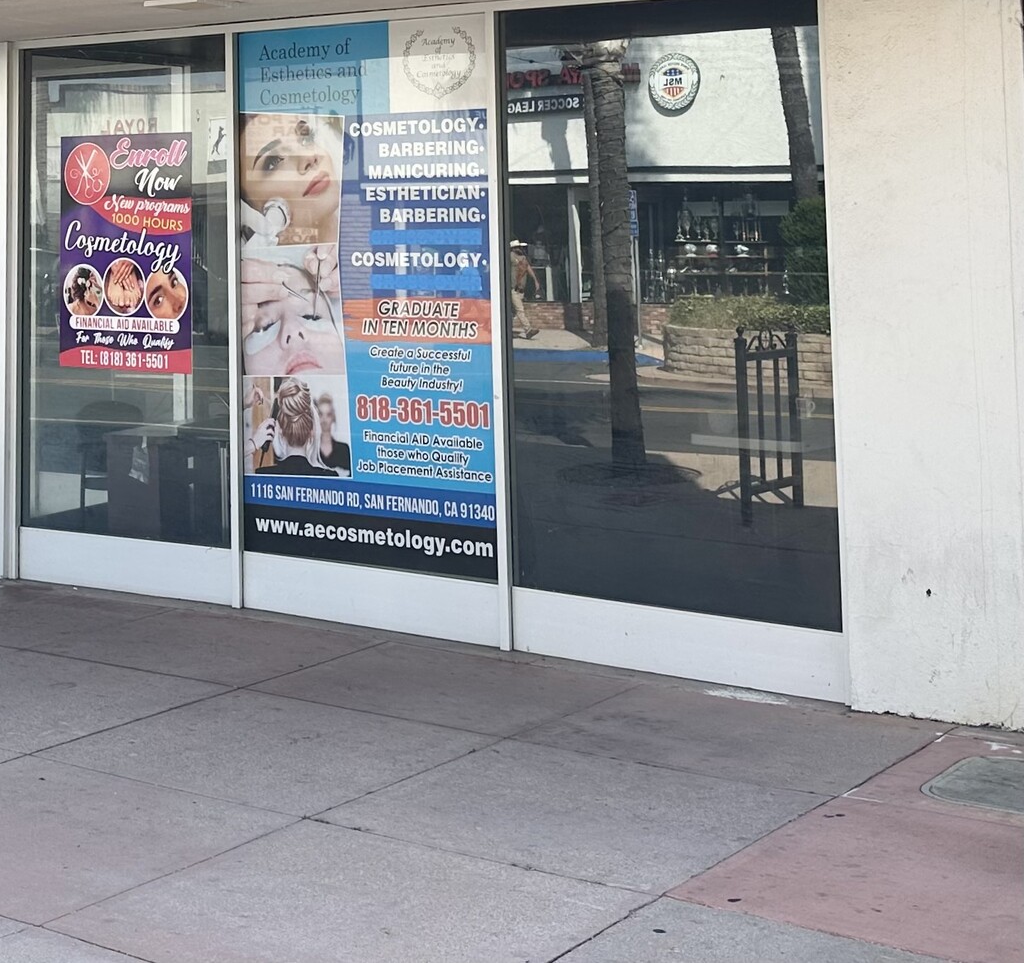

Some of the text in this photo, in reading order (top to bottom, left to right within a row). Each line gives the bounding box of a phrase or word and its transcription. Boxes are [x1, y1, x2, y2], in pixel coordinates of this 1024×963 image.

[258, 37, 352, 61] Academy of
[420, 35, 456, 48] Academy
[260, 60, 368, 83] Esthetics and
[260, 85, 361, 106] Cosmetology
[109, 137, 188, 170] Enroll
[134, 167, 183, 198] Now
[103, 194, 191, 217] New programs
[111, 213, 184, 231] 1000 HOURS
[64, 219, 182, 273] Cosmetology
[378, 300, 460, 318] GRADUATE
[75, 317, 174, 332] FINANCIAL AID AVAILABLE
[362, 319, 478, 339] IN TEN MONTHS
[76, 330, 175, 350] For Those Who Qualify
[80, 349, 169, 369] TEL: (818) 361-5501
[369, 346, 472, 362] Create a Successful
[389, 362, 450, 375] future in the
[380, 376, 464, 394] Beauty Industry!
[356, 395, 491, 429] 818-361-5501
[363, 430, 484, 450] Financial AID Available
[377, 447, 470, 466] those who Qualify
[357, 460, 493, 483] Job Placement Assistance
[250, 483, 495, 522] 1116 SAN FERNANDO RD, SAN FERNANDO, CA 91340
[255, 516, 495, 558] www.aecosmetology.com
